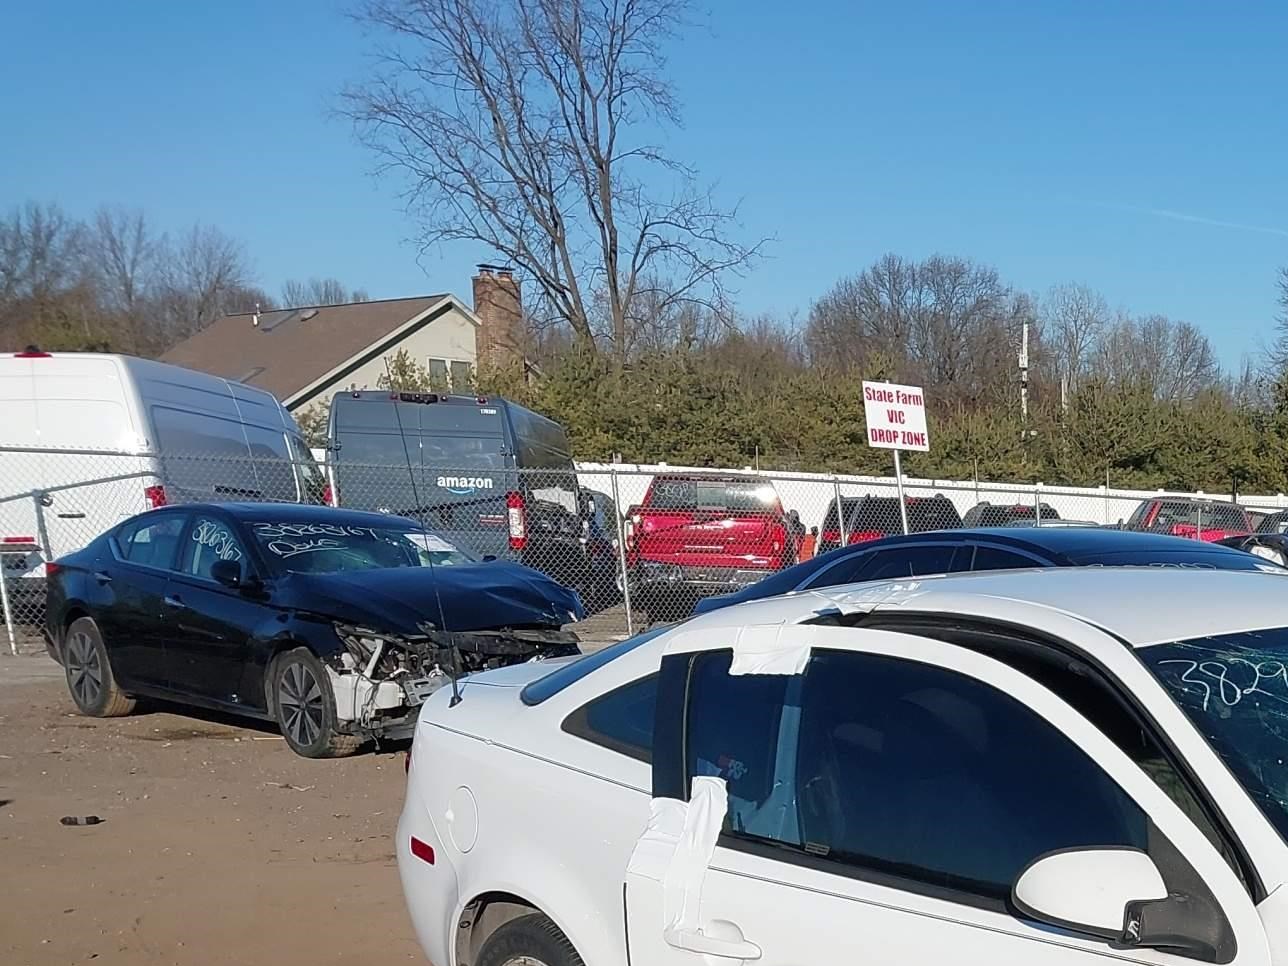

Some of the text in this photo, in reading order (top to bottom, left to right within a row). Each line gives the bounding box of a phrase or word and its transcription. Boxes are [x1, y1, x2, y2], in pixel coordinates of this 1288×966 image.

[865, 387, 922, 406] State Farm
[887, 409, 905, 424] VIC
[870, 428, 927, 446] DROP ZONE
[437, 475, 493, 490] amazon
